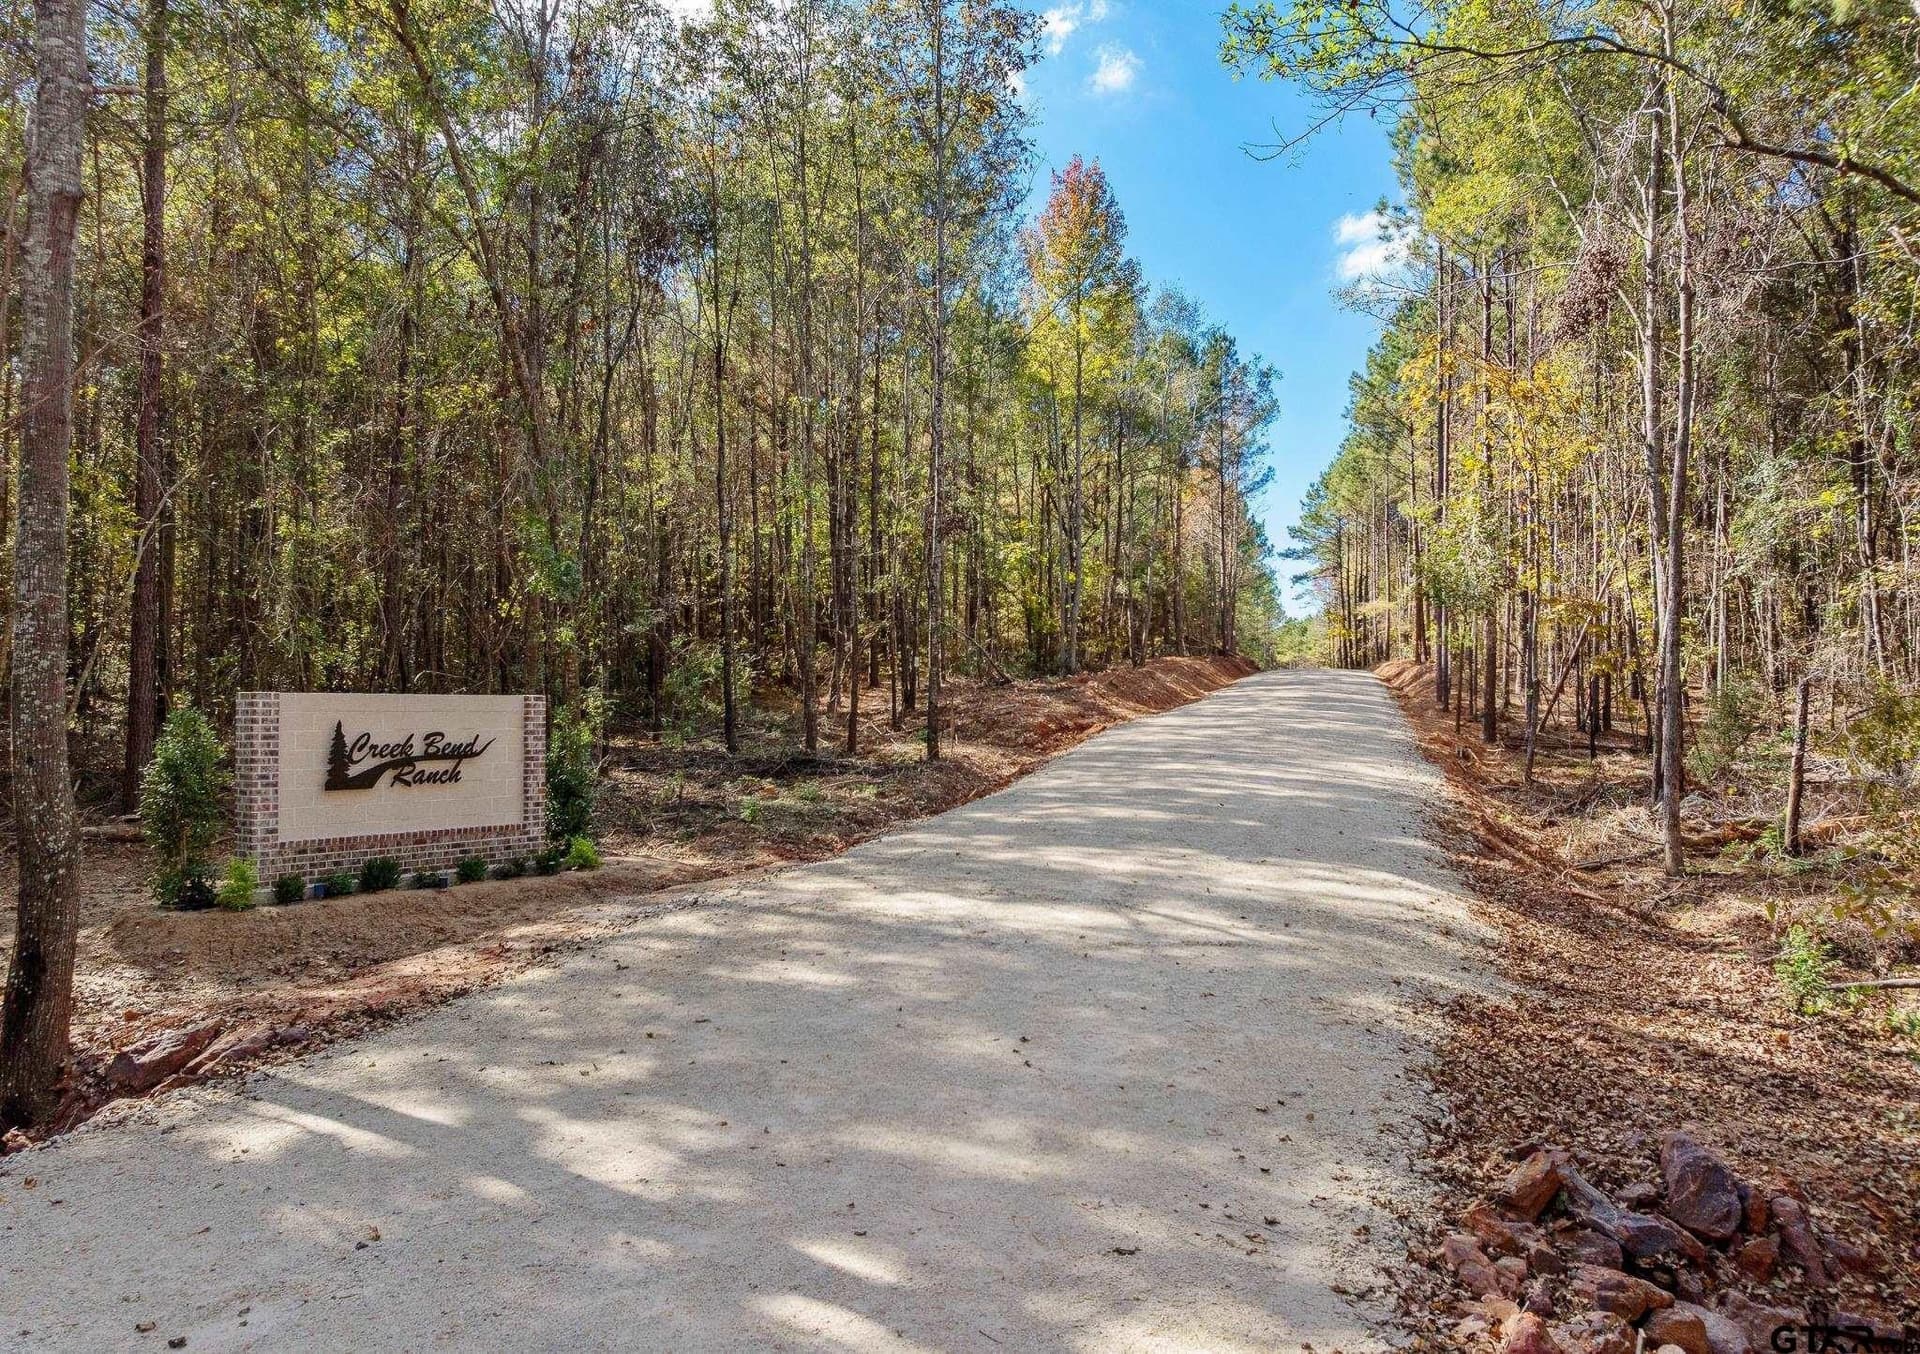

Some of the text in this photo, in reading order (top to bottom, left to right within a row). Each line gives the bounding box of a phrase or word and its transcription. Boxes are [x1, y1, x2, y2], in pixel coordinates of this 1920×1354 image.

[349, 731, 480, 764] Creek Bend
[391, 759, 462, 787] Ranch
